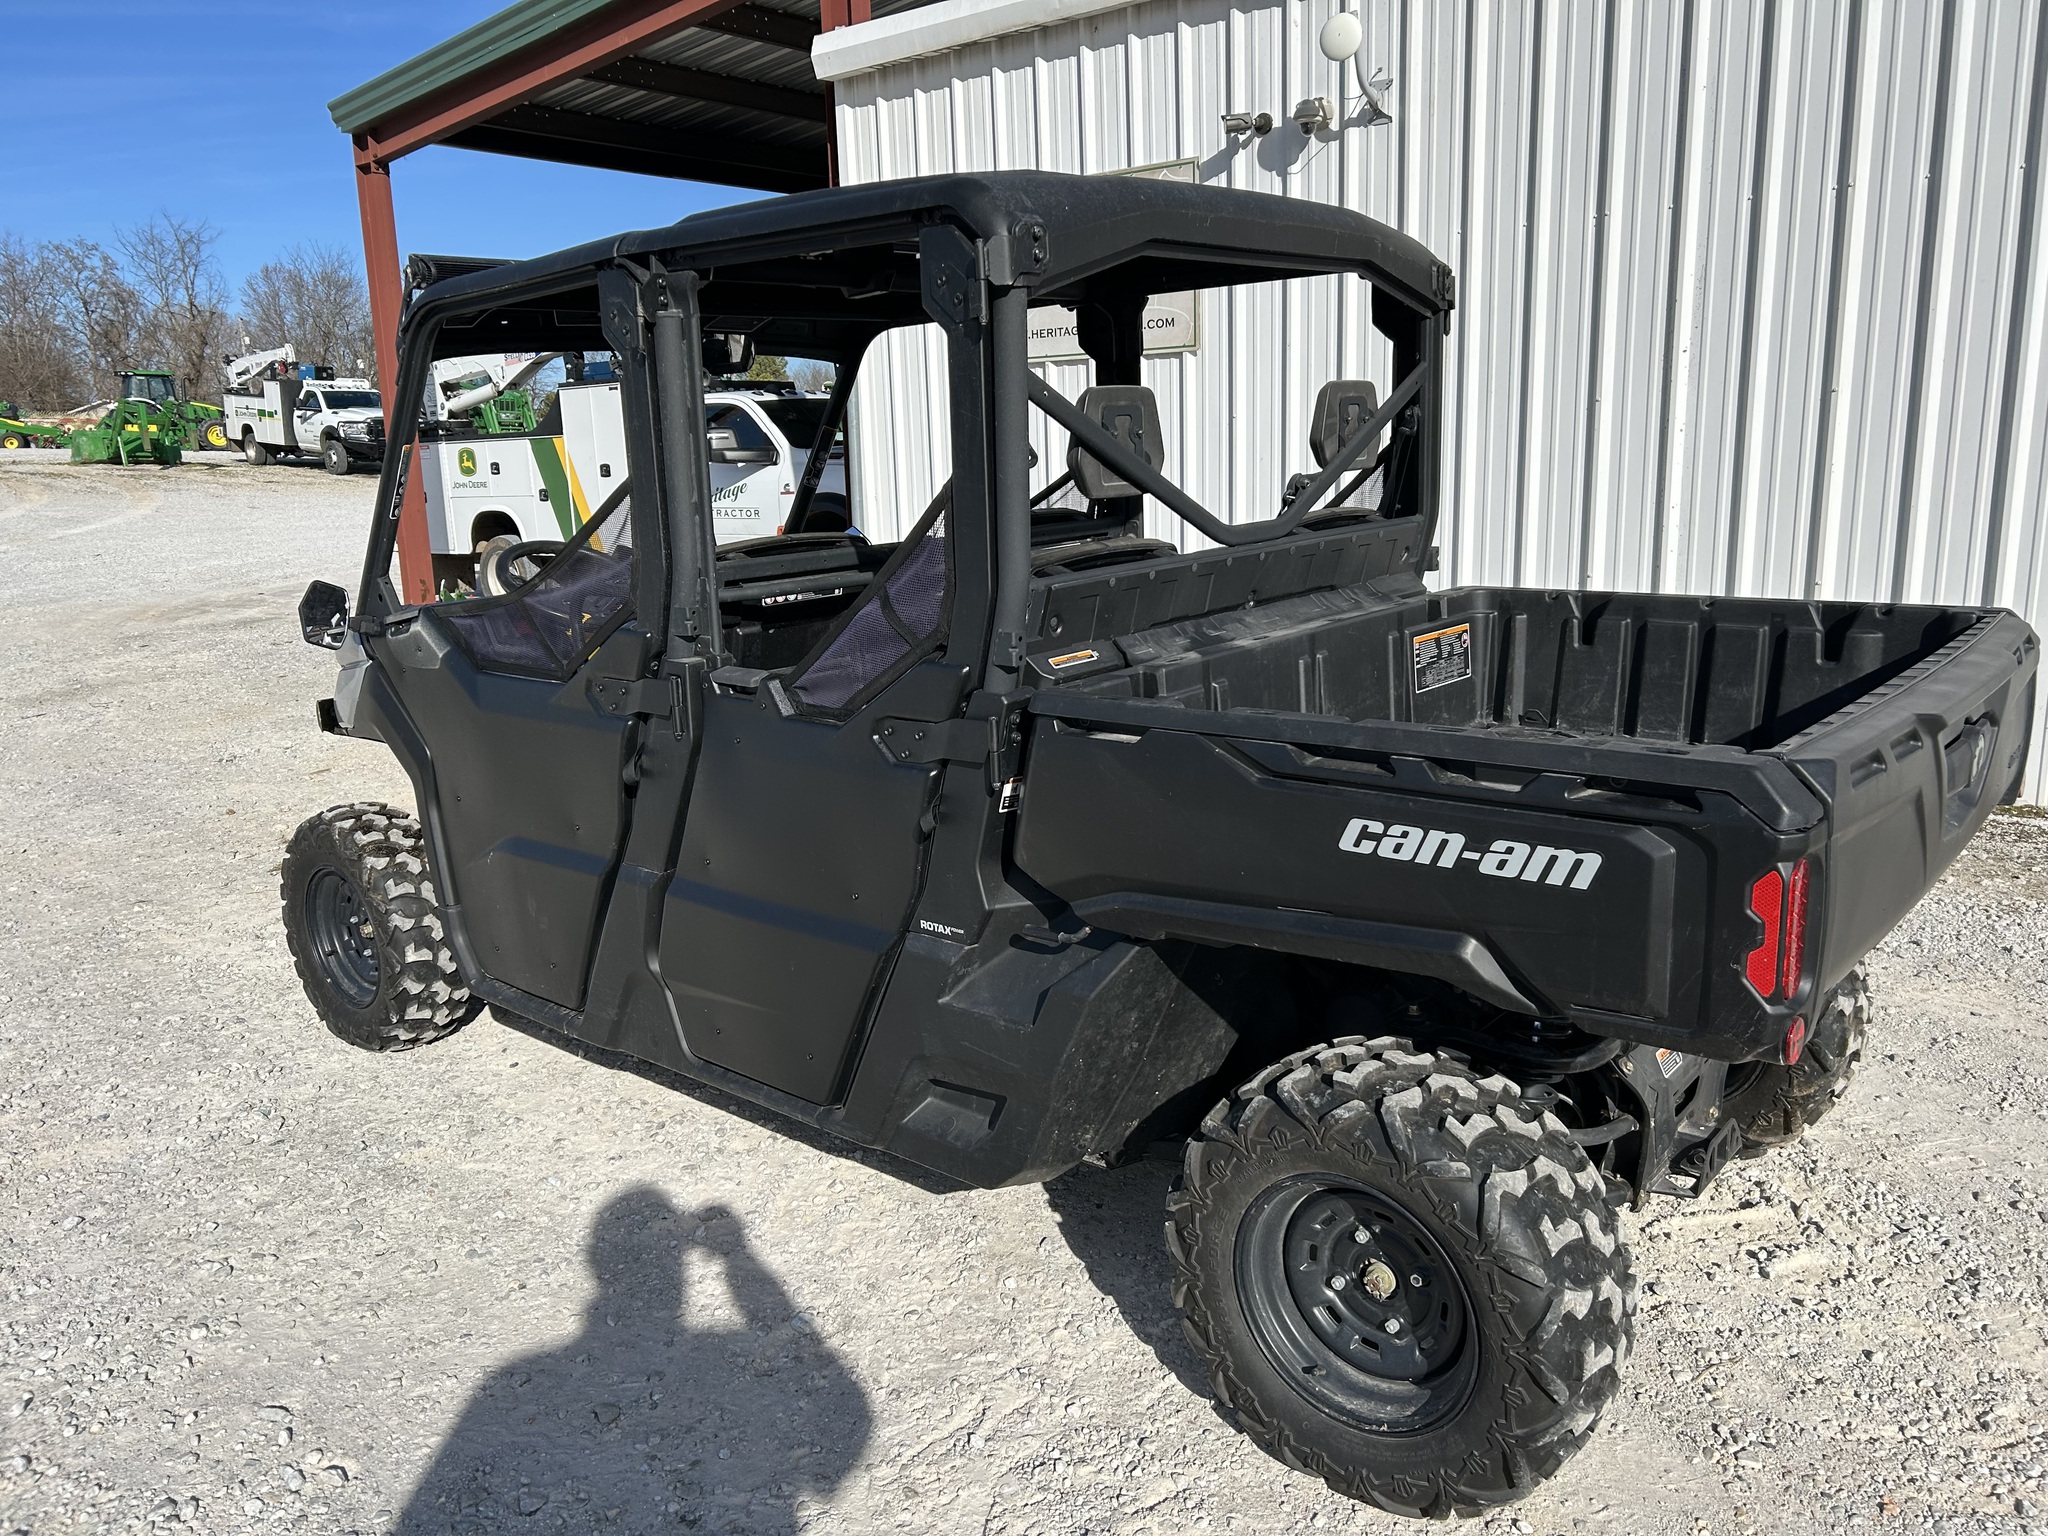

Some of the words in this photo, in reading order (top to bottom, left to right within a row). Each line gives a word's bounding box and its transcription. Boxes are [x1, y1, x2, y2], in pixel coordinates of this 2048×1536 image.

[452, 481, 468, 489] JOHN
[468, 481, 488, 489] DEERE
[1338, 817, 1602, 890] can-am
[920, 919, 951, 936] ROTAX
